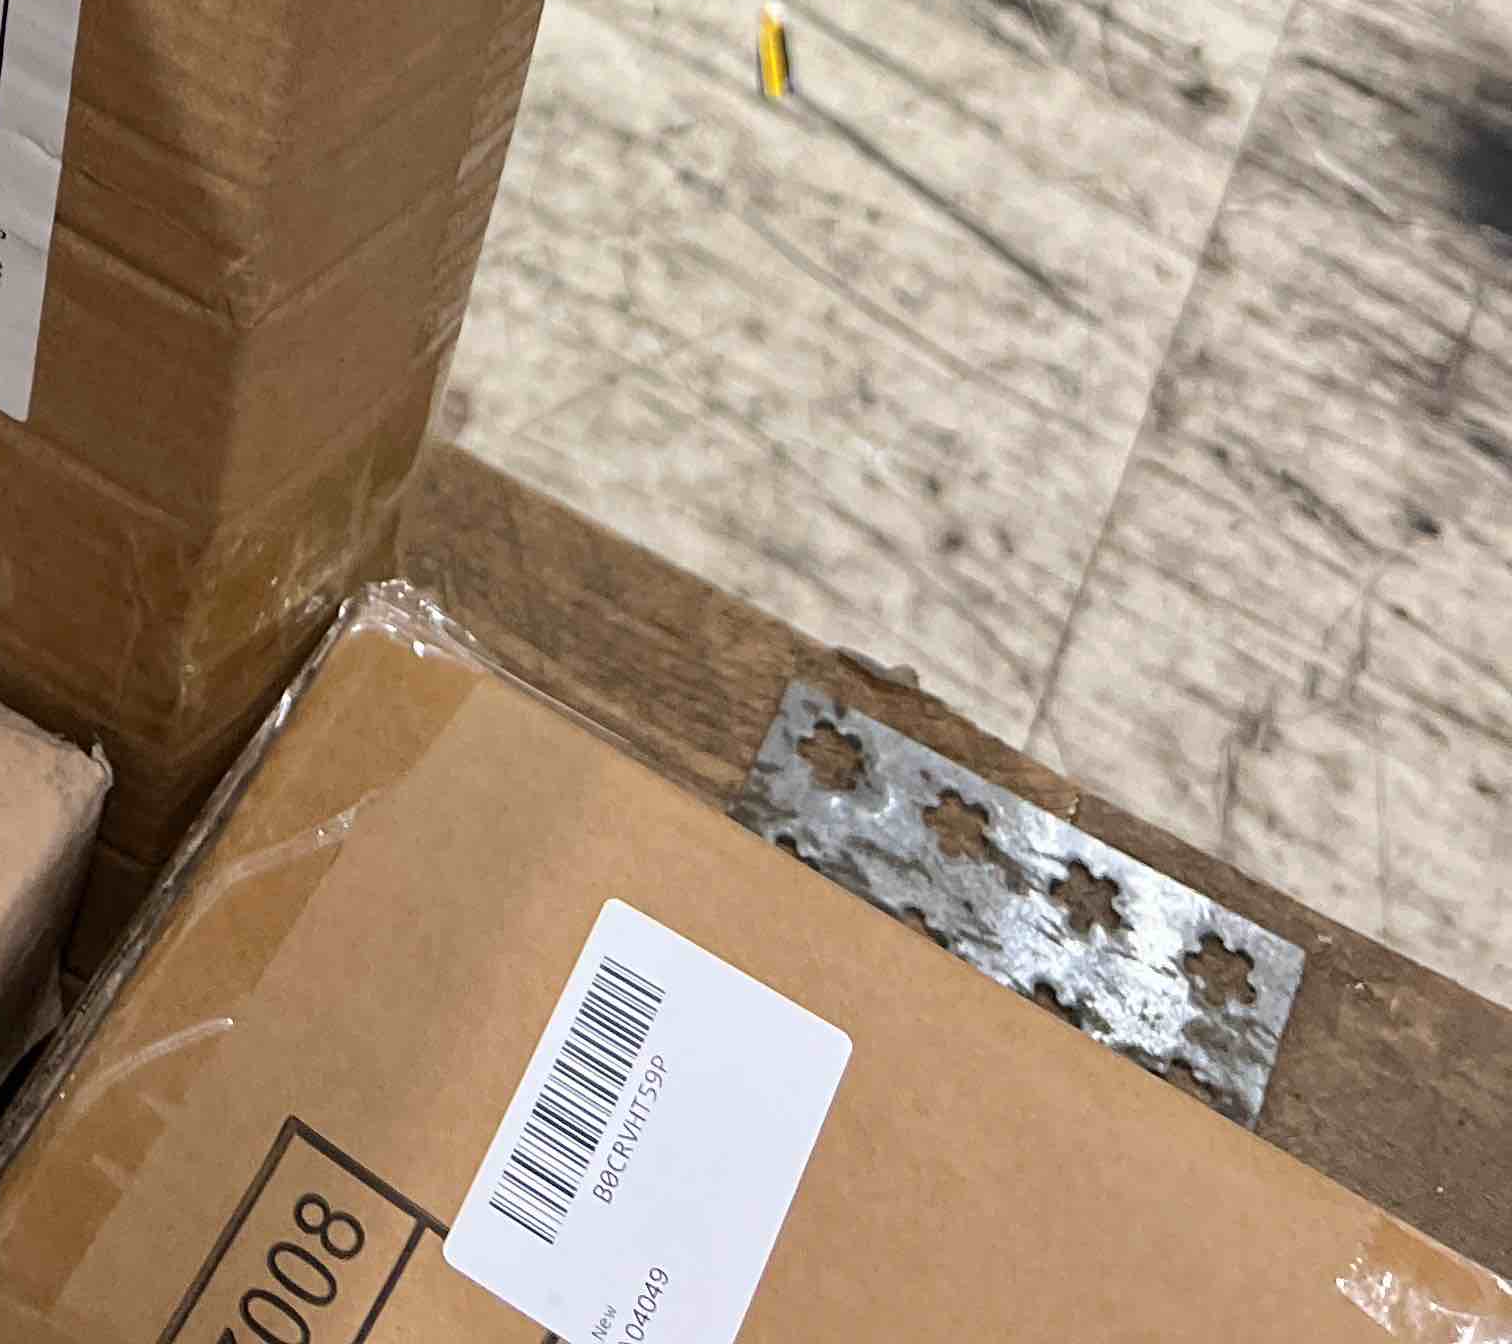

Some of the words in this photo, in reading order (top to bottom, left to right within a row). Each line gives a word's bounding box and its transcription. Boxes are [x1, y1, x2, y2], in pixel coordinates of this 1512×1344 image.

[215, 1193, 366, 1344] 008
[617, 1267, 670, 1344] 04049
[591, 1304, 617, 1342] New
